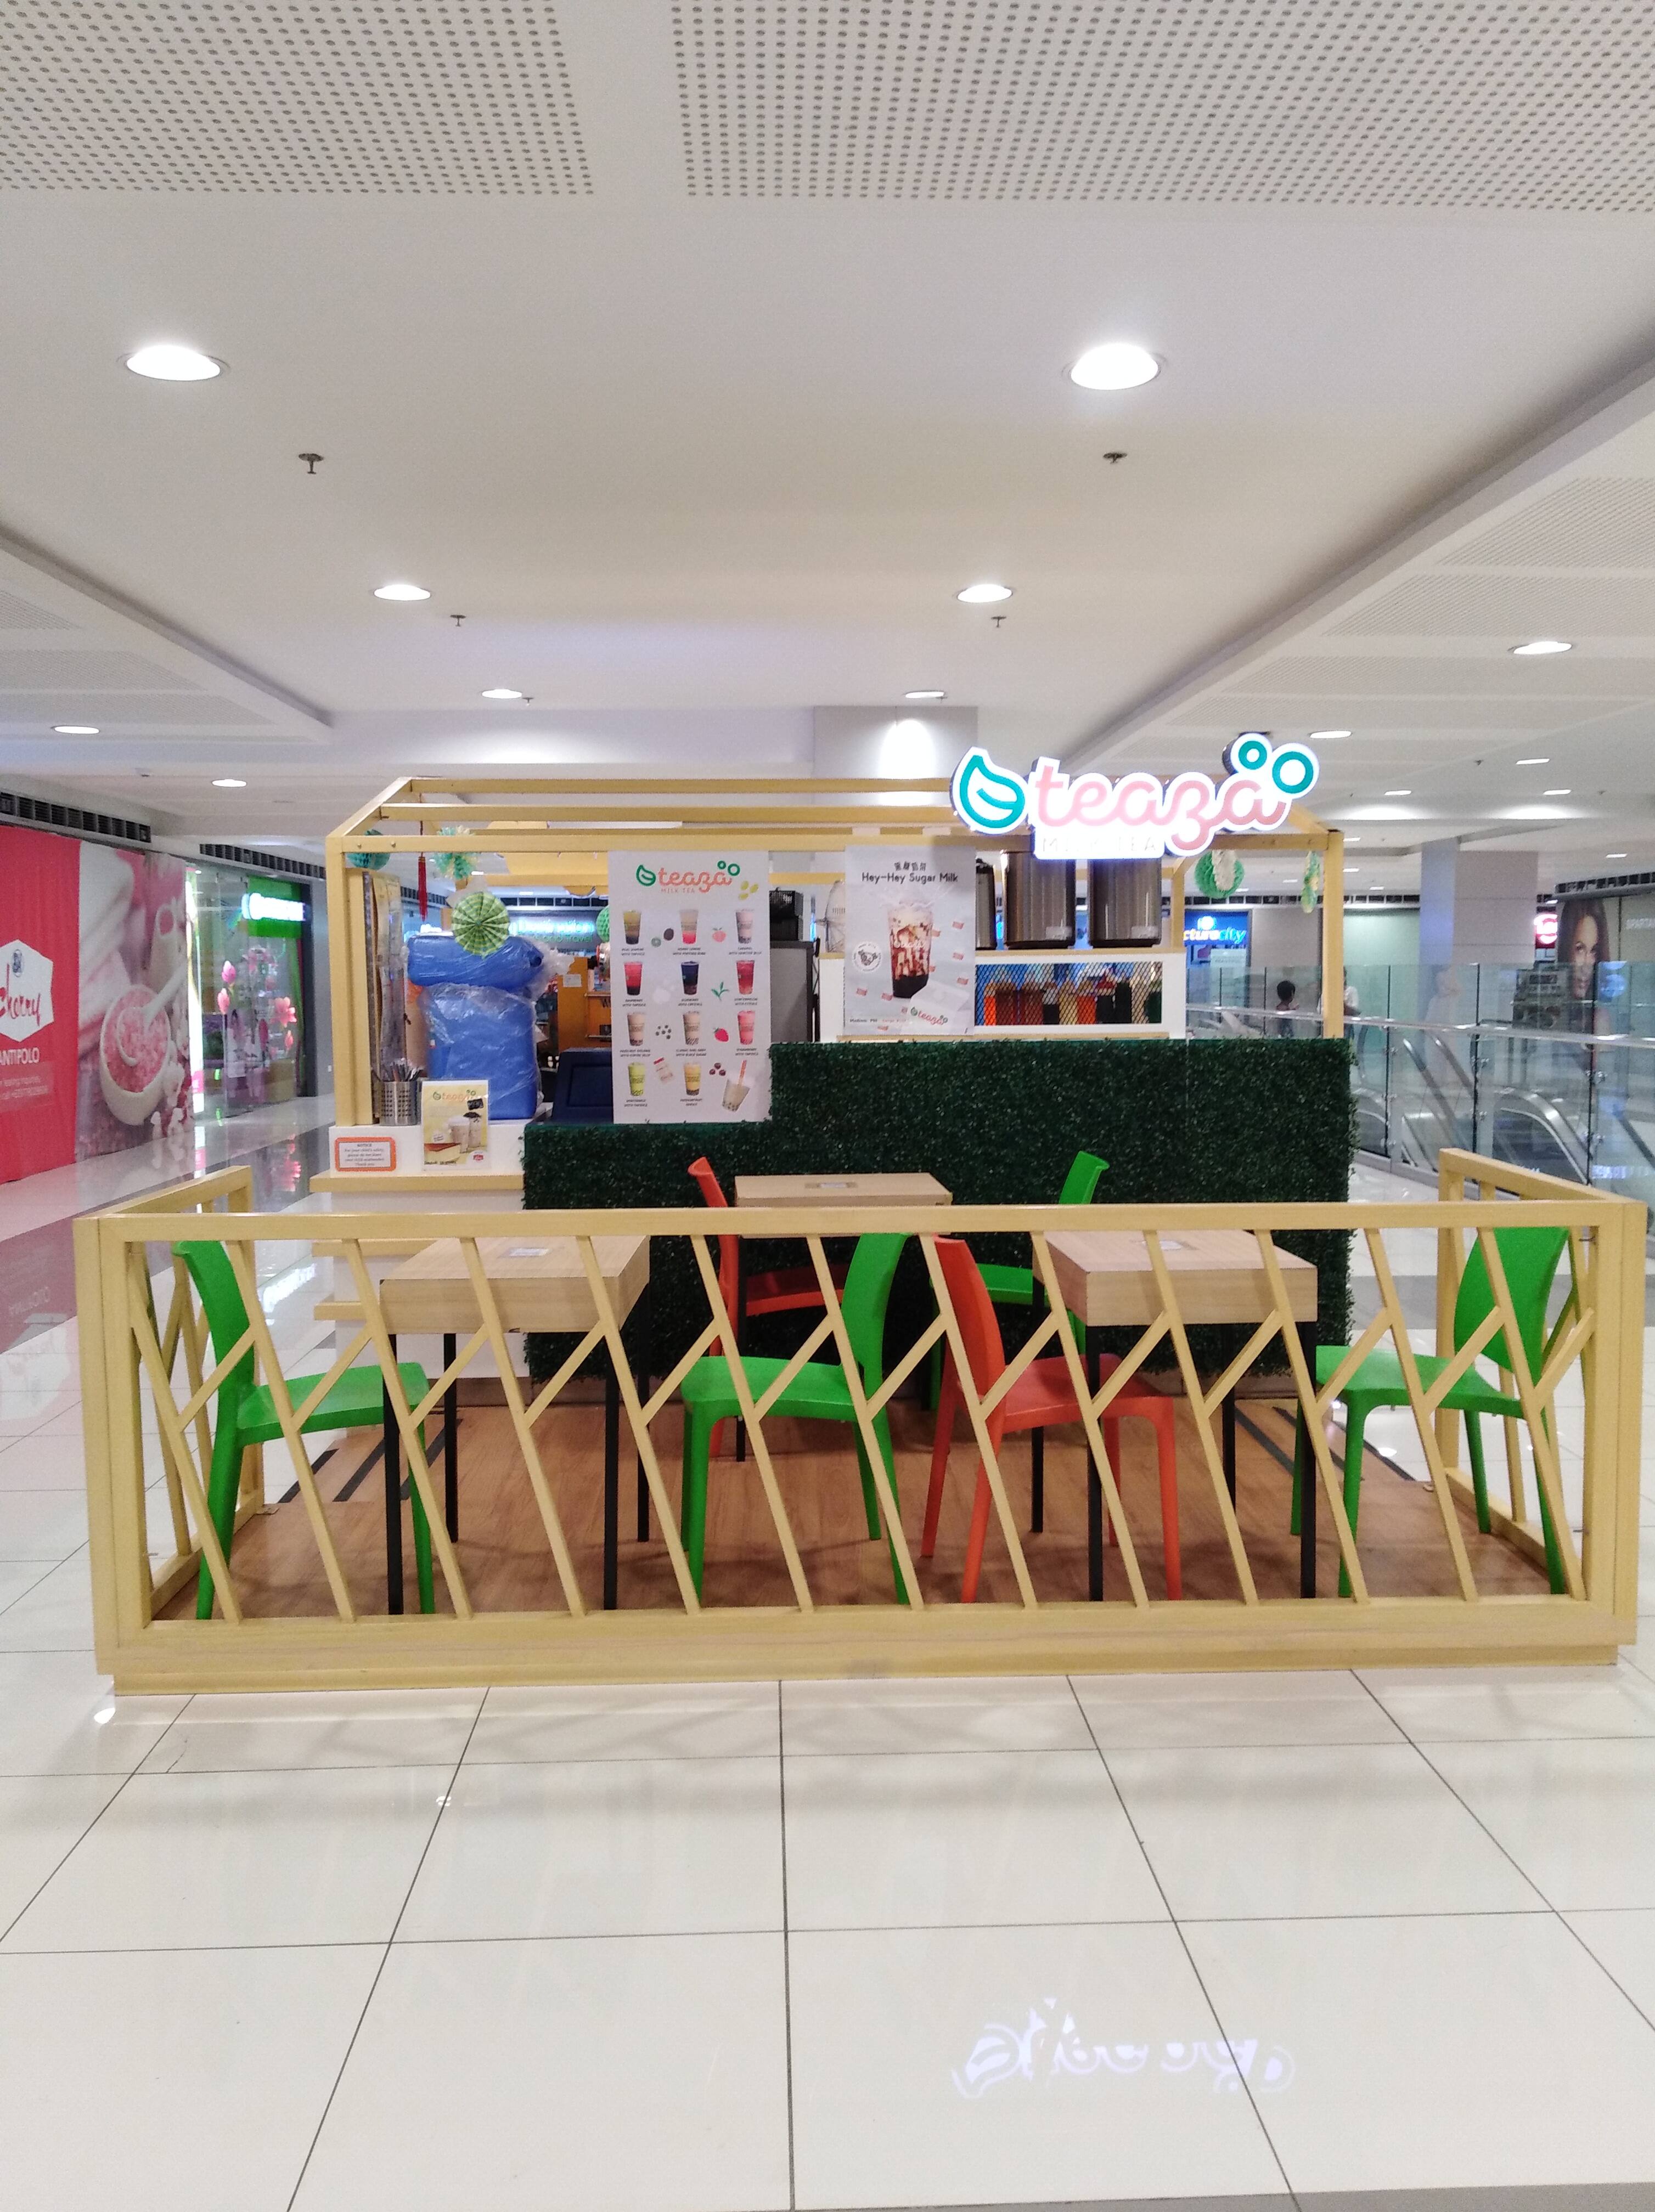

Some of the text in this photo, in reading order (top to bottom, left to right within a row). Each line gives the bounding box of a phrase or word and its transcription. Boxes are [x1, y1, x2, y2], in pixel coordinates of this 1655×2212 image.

[1035, 766, 1287, 851] teaza
[658, 867, 733, 893] teaza
[909, 872, 936, 885] Sugar
[939, 872, 959, 883] Milk
